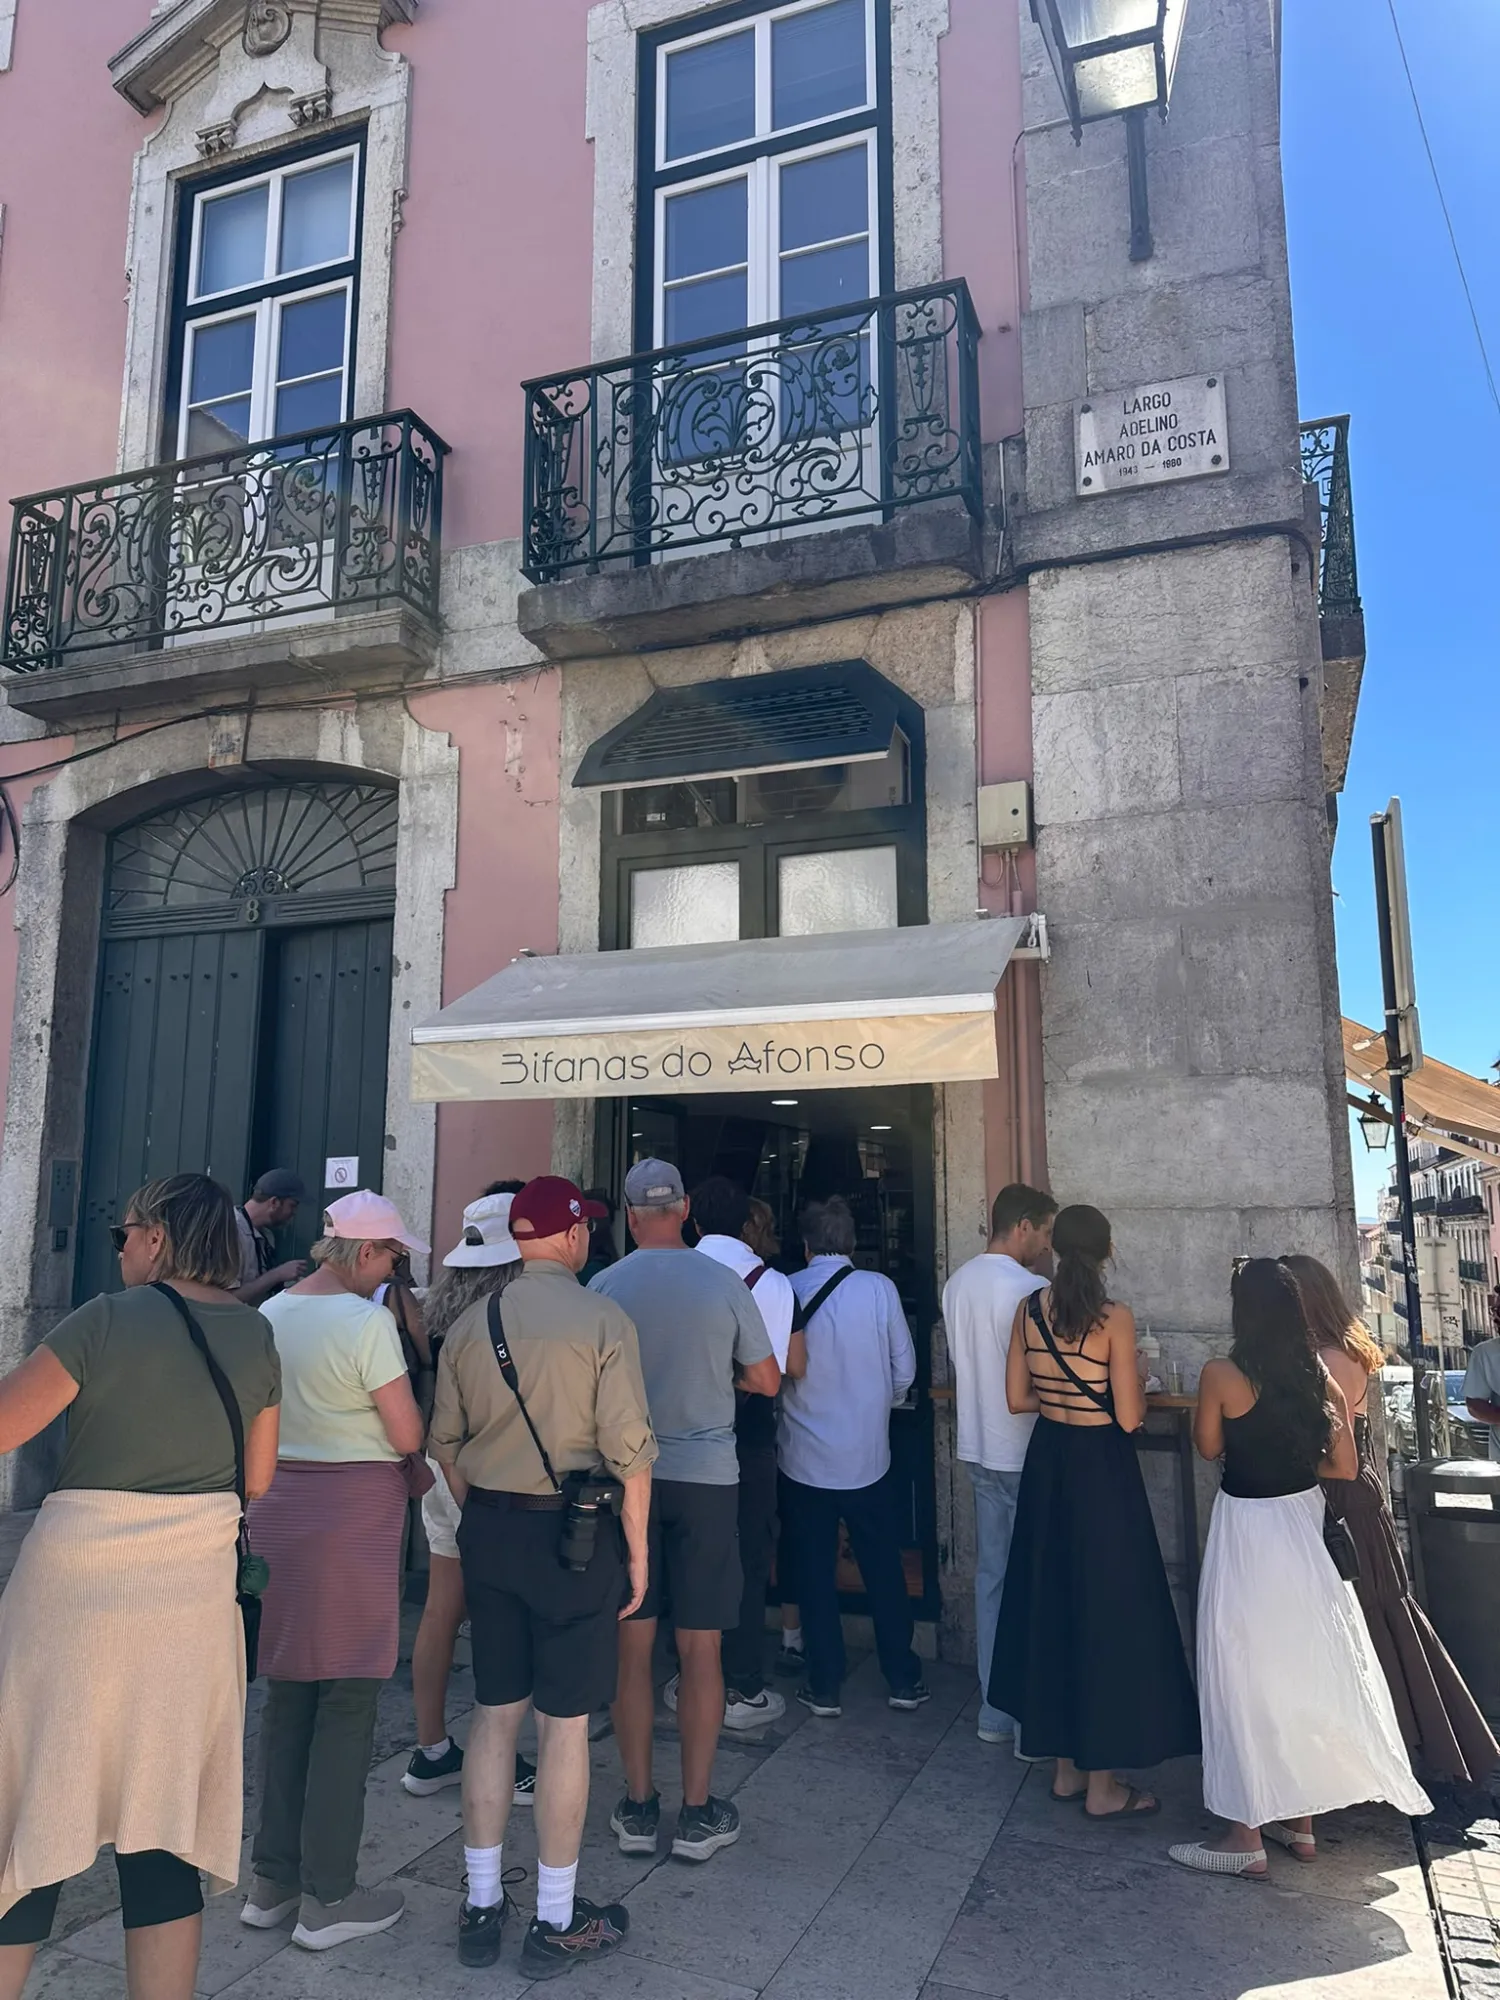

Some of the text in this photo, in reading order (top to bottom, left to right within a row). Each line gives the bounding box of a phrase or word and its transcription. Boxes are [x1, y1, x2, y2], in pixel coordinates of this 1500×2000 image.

[1123, 392, 1171, 415] LARGO
[1119, 413, 1178, 439] ADELINO
[1084, 429, 1216, 467] AMARO DA COSTA
[247, 899, 259, 922] 8
[500, 1040, 885, 1084] Bifanas do Afonso
